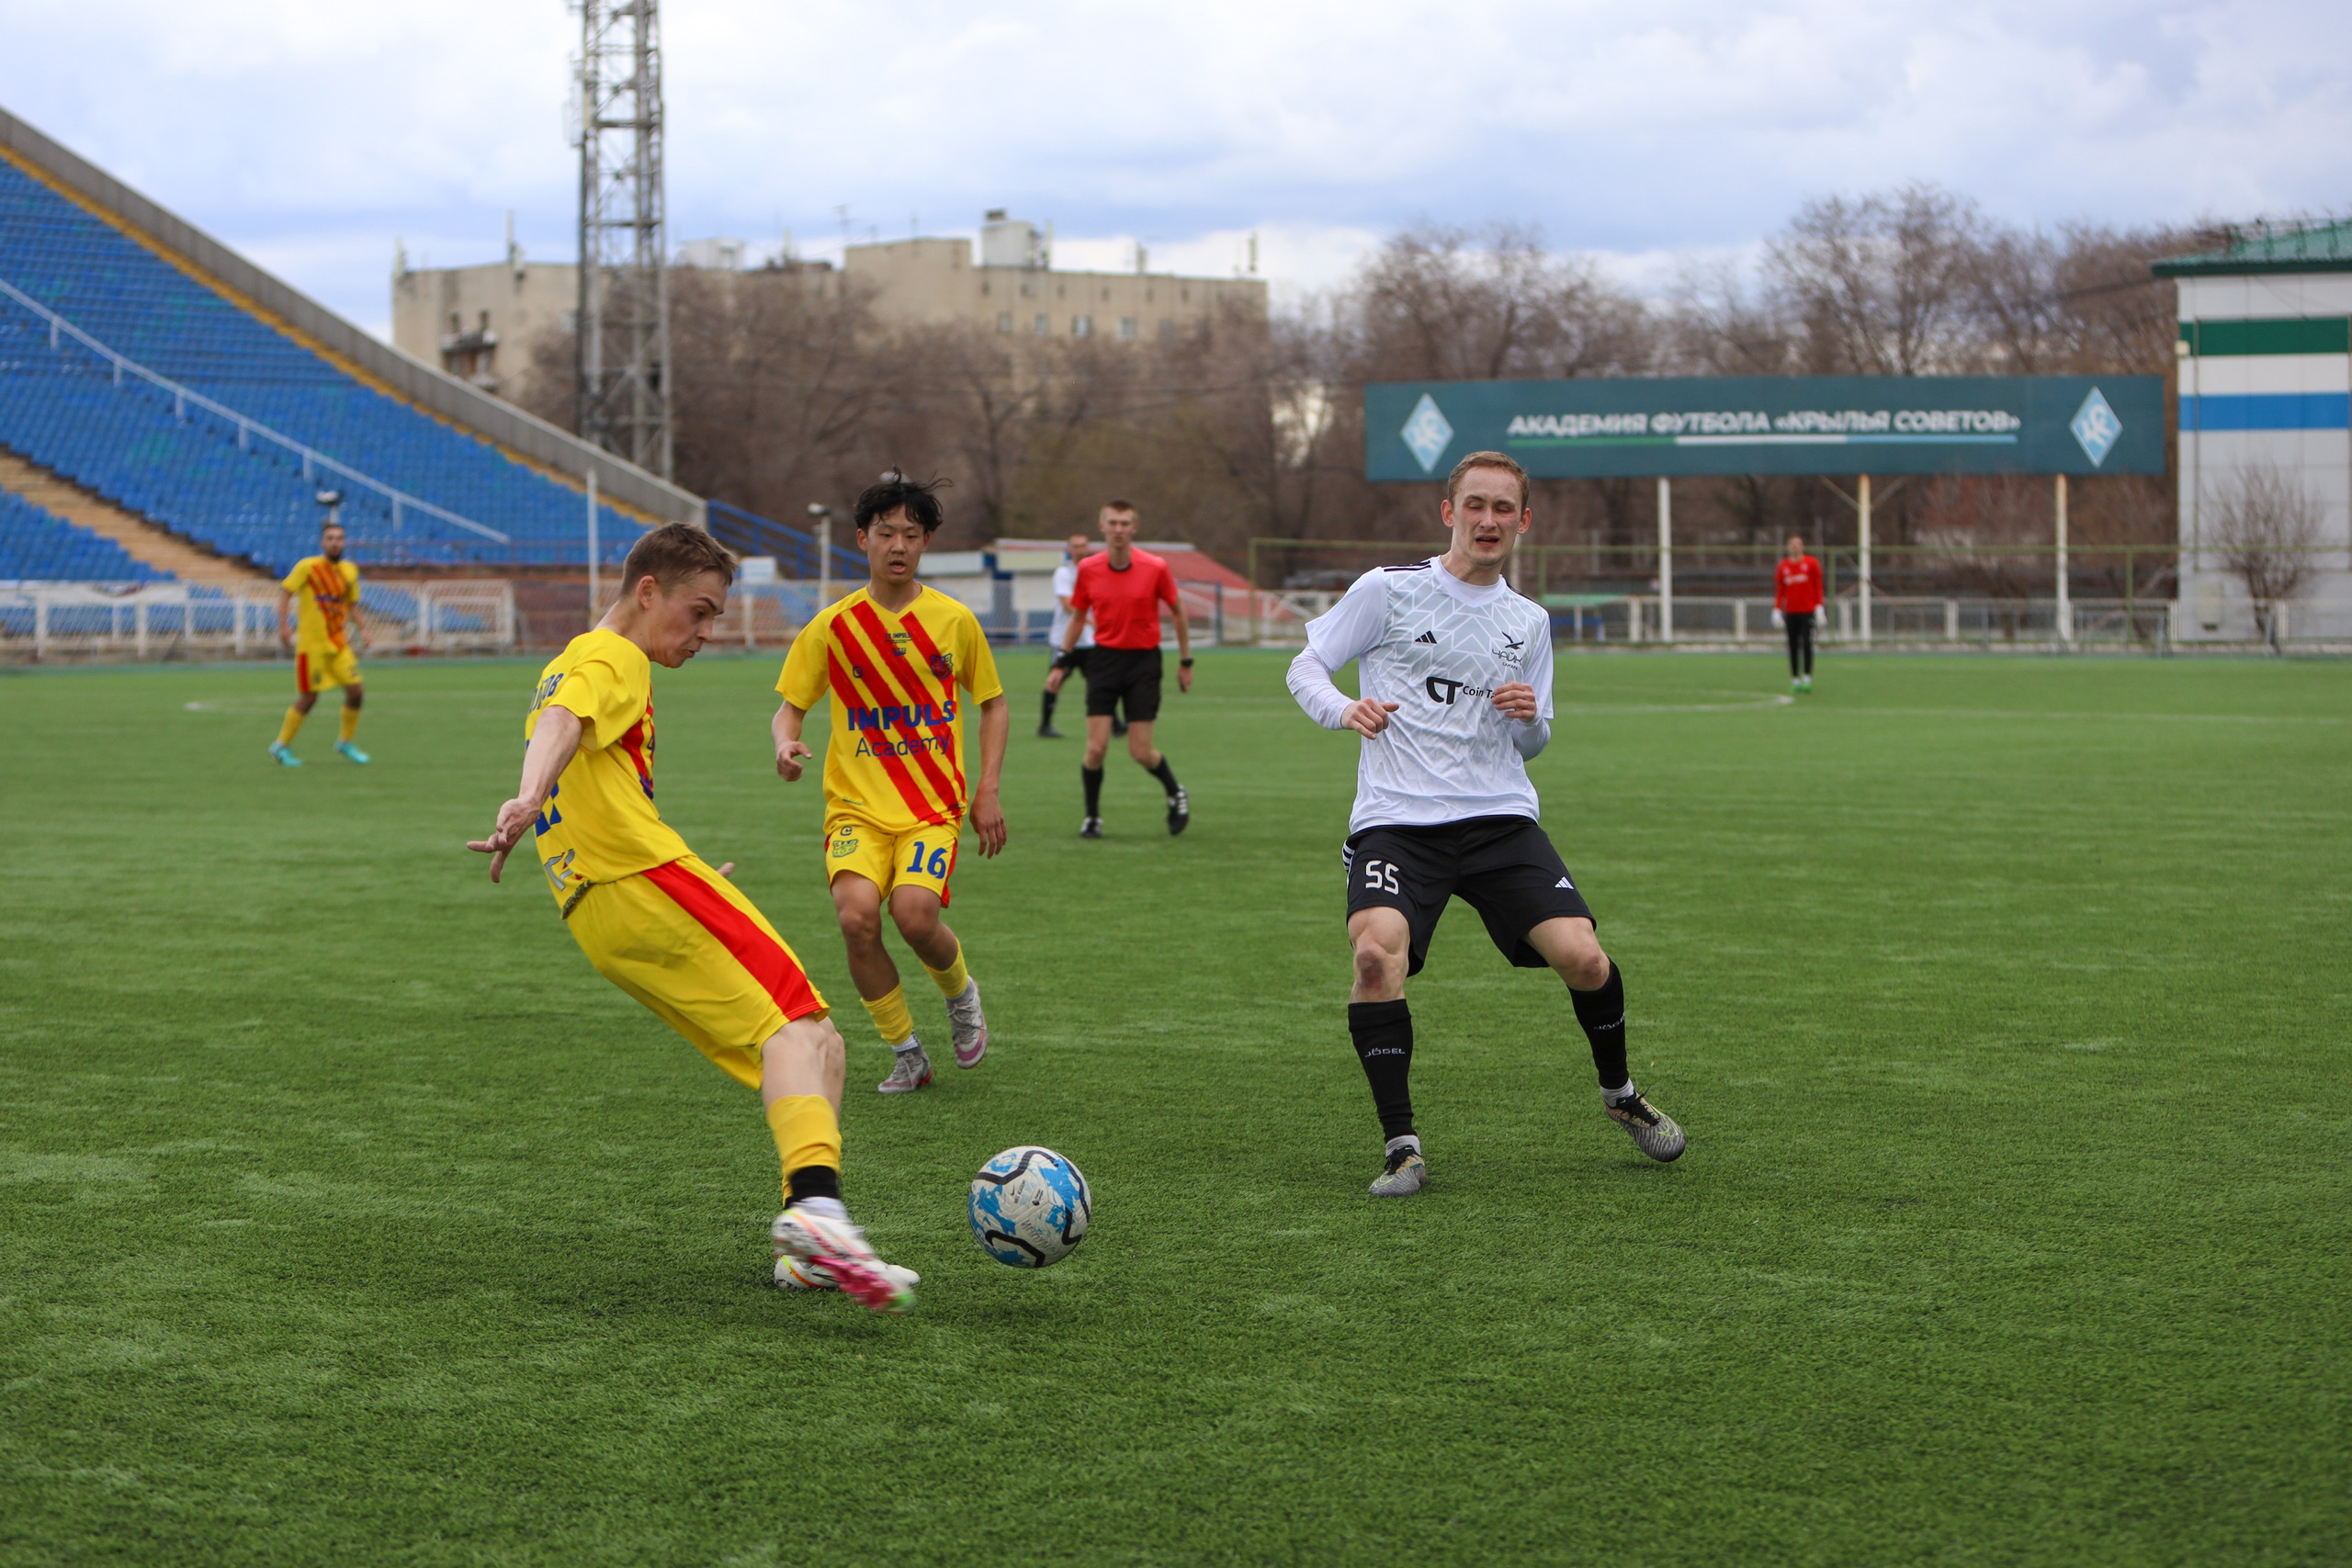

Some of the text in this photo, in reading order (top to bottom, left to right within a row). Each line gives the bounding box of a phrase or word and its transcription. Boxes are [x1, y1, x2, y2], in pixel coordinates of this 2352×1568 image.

[1507, 411, 2020, 437] АКАДЕМИЯ ФУТБОЛА «КРЫЛЬЯ СОВЕТОВ»
[1463, 685, 1484, 697] Coin
[847, 700, 955, 731] IMPULS
[855, 734, 950, 758] Academy
[906, 840, 948, 879] 16
[1365, 860, 1399, 896] 55
